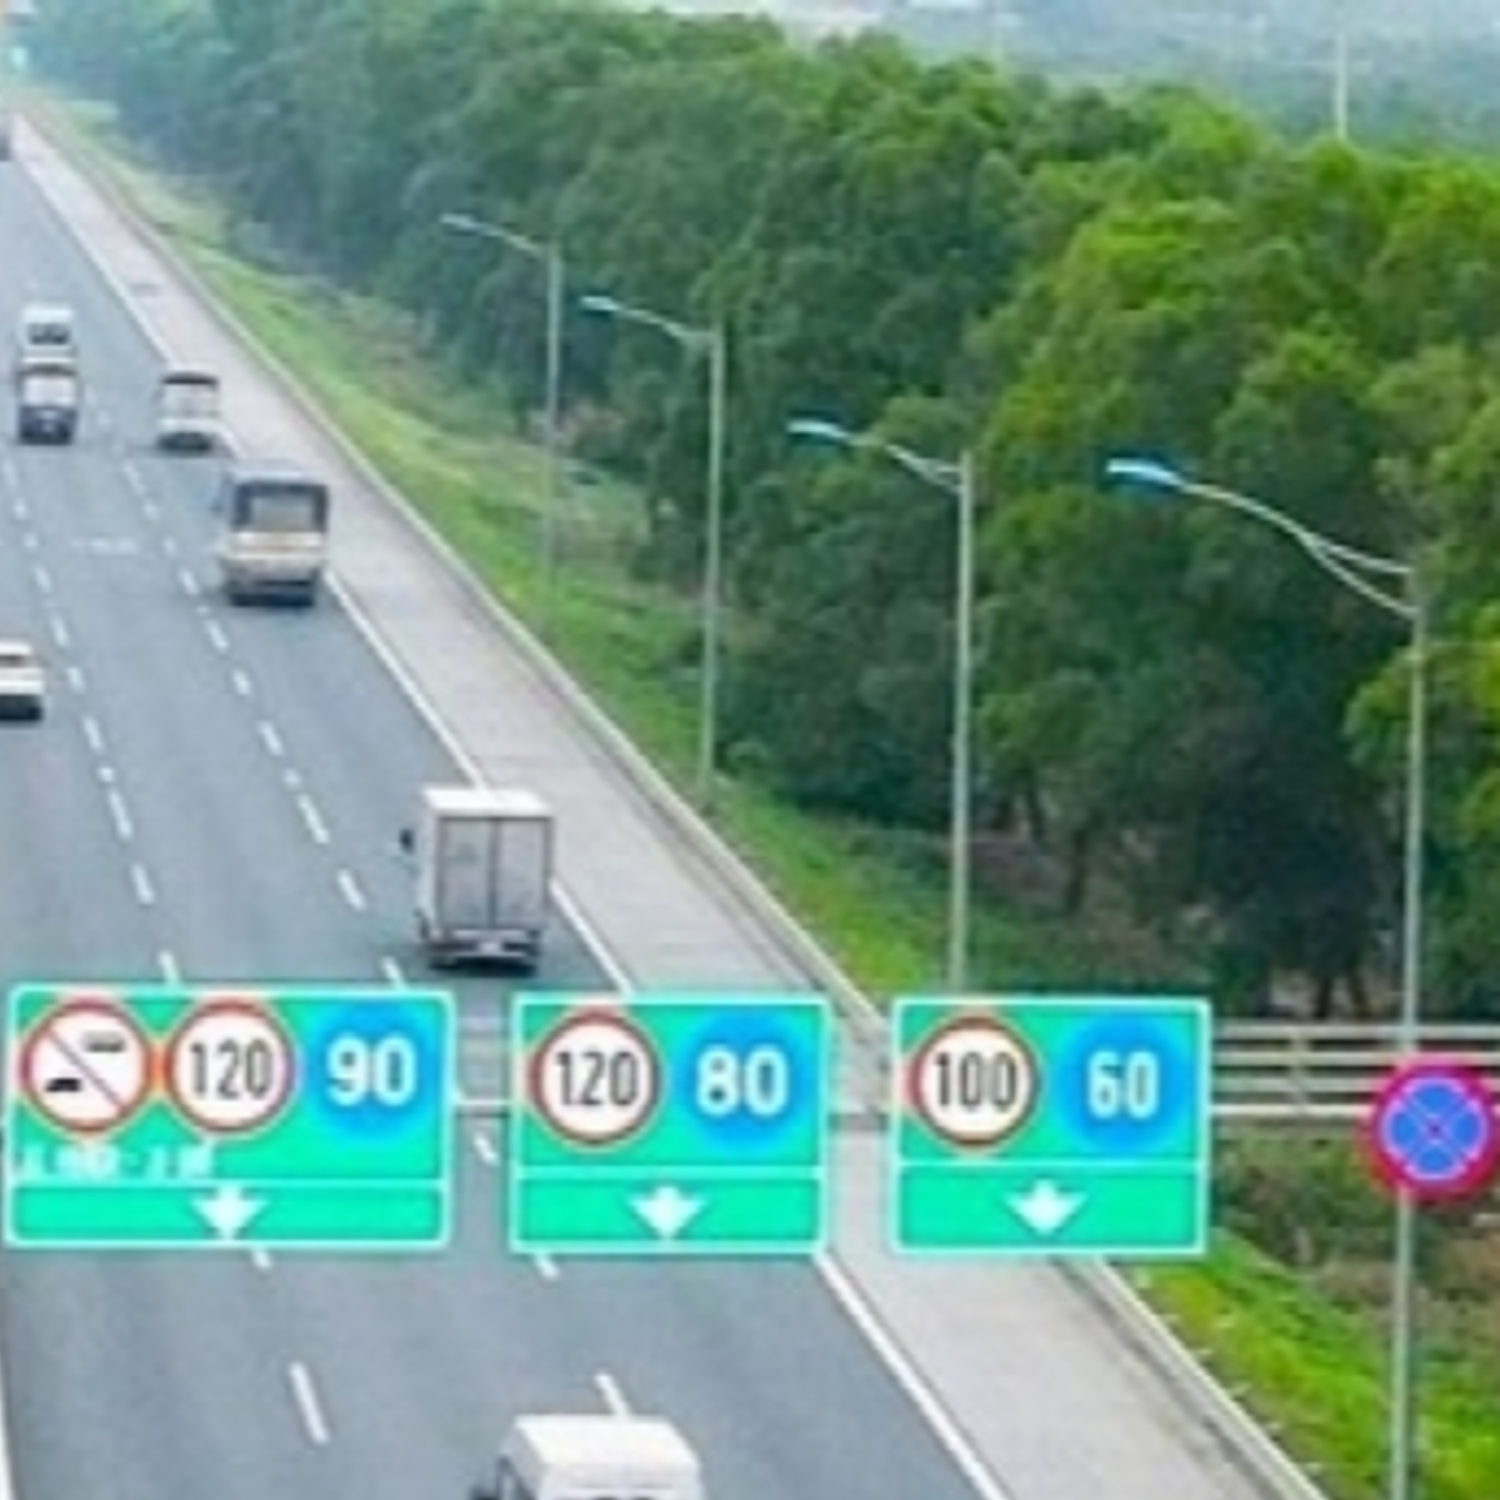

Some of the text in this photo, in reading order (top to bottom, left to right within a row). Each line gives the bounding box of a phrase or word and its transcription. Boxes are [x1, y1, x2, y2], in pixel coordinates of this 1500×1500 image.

[192, 1039, 274, 1099] 120
[326, 1032, 418, 1105] 90
[556, 1049, 640, 1107] 120
[696, 1046, 789, 1117] 80
[933, 1051, 1018, 1111] 100
[1087, 1050, 1161, 1119] 60
